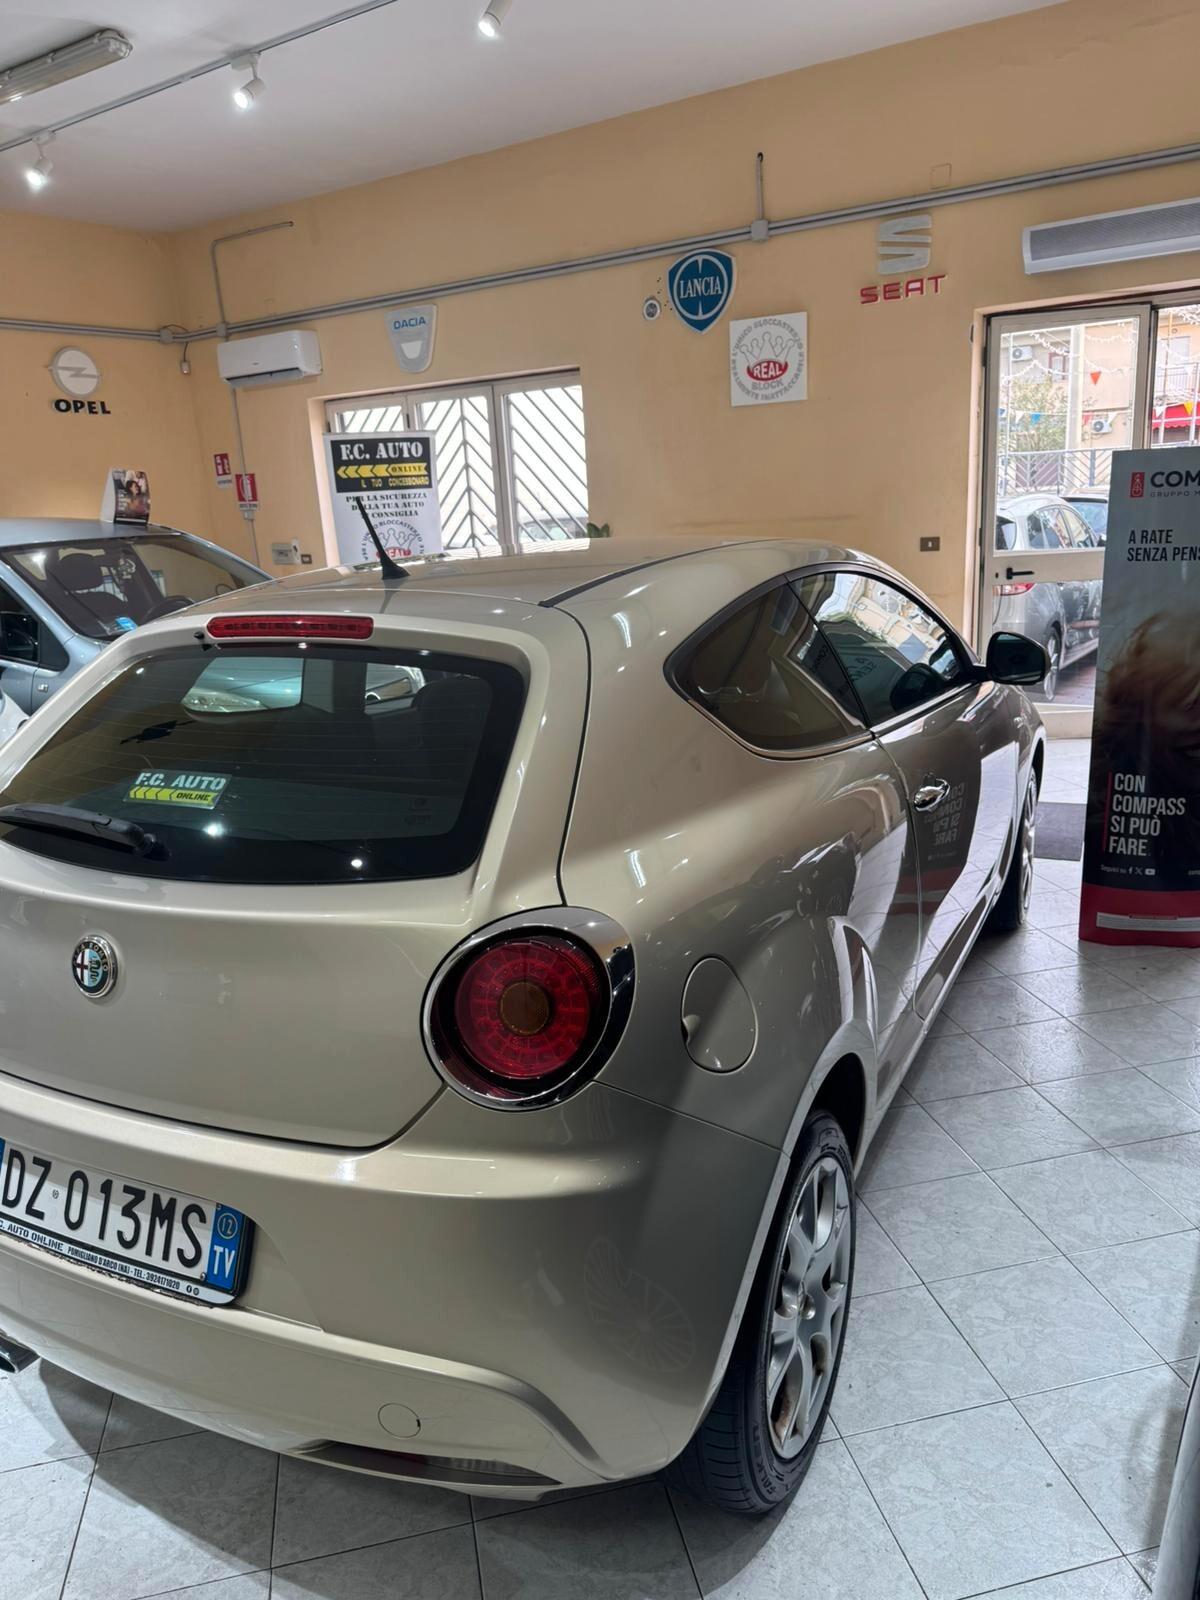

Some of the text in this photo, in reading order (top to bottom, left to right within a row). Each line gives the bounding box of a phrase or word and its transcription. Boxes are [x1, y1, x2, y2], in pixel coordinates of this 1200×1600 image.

[679, 275, 722, 298] LANCIA
[860, 274, 946, 304] SEAT
[393, 316, 426, 330] DACIA
[753, 362, 783, 378] REAL
[751, 379, 784, 391] BLOCK
[54, 398, 111, 415] OPEL
[376, 441, 424, 459] AUTO
[391, 465, 422, 473] ONLINE
[379, 492, 427, 500] SICUREZZA
[1150, 490, 1190, 498] GRUPPO
[351, 501, 425, 511] DLLA TUA AUTO
[371, 510, 418, 519] CONSIGLIA
[1128, 529, 1173, 544] A RATE
[1127, 547, 1168, 562] SENZA
[135, 772, 227, 791] F.C. AUTO
[1114, 773, 1146, 793] CON
[176, 792, 212, 801] ONLINE
[1112, 794, 1186, 816] COMPASS
[1110, 815, 1161, 836] SI PUÒ
[1, 1148, 53, 1221] DZ
[219, 1217, 234, 1235] 12
[7, 1223, 30, 1239] AUTO
[31, 1232, 64, 1251] ONLINE
[67, 1246, 98, 1266] POMIGLIANO
[98, 1255, 118, 1271] D'ARCO
[213, 1244, 236, 1279] TV
